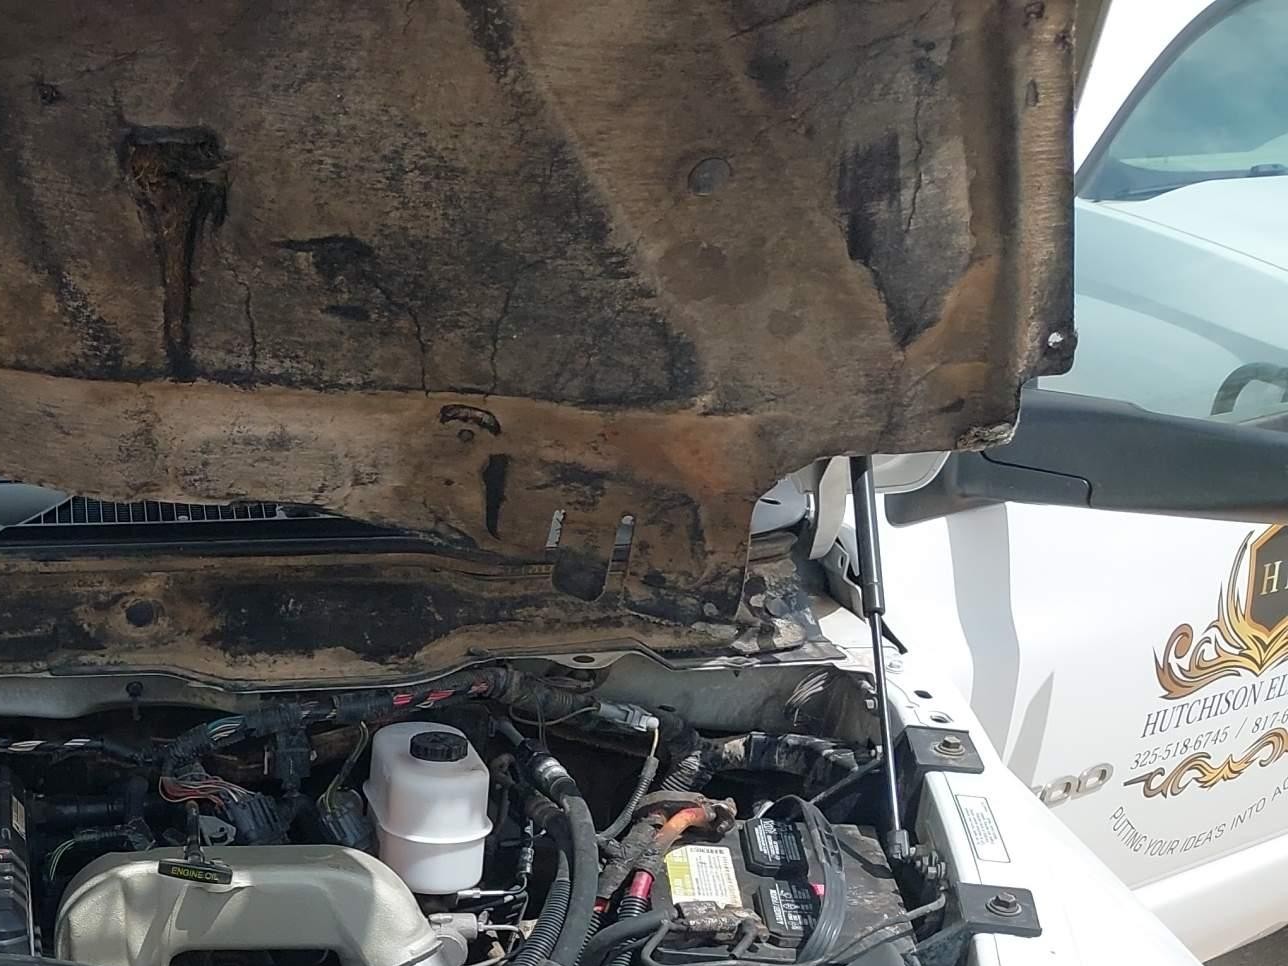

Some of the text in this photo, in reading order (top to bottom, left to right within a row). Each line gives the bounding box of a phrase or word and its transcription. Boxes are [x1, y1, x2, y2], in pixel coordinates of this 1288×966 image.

[1260, 560, 1284, 596] H
[1141, 673, 1288, 739] HUTCHISON EL
[1130, 725, 1231, 771] 325-518-6745
[1036, 763, 1114, 808] 00
[1109, 805, 1148, 853] PUTTING
[1143, 839, 1180, 857] YOUR
[1179, 822, 1227, 853] IDEA'S
[1230, 797, 1267, 831] INTO
[171, 866, 219, 881] ENGINE OIL
